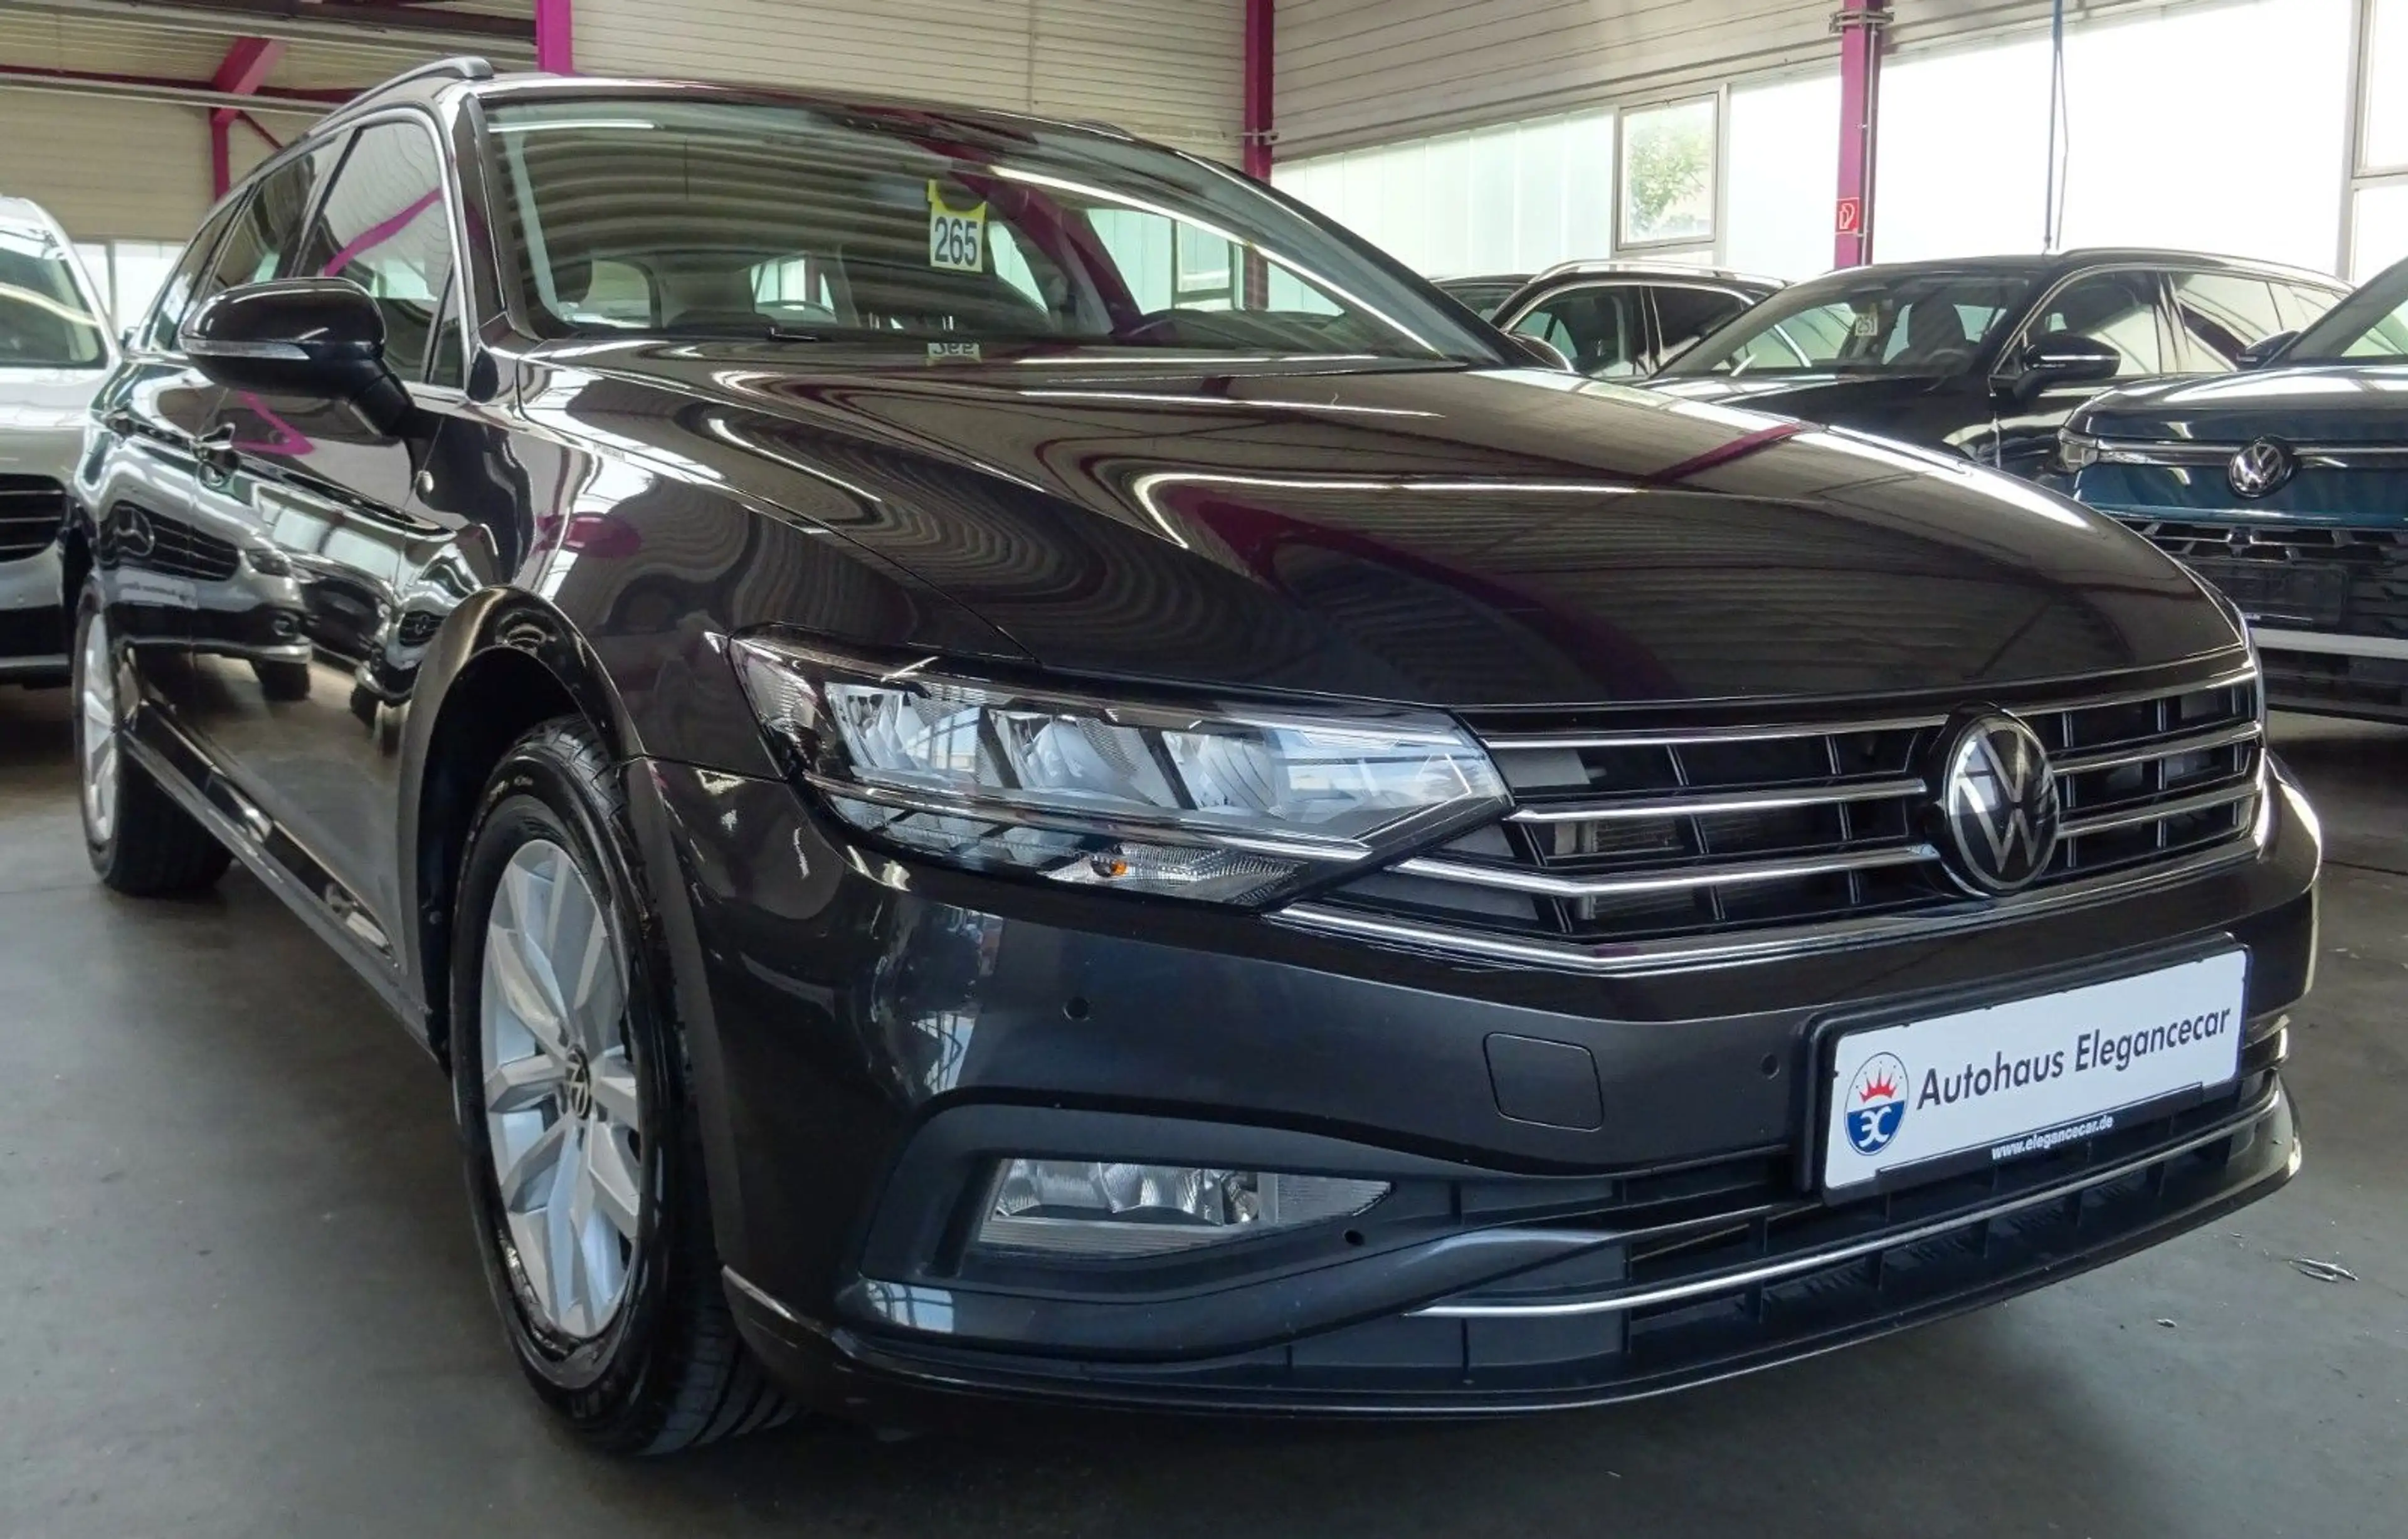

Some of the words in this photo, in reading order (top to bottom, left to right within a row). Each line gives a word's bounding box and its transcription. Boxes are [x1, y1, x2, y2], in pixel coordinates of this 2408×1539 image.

[934, 216, 977, 266] 265
[1950, 723, 2058, 879] VW
[1916, 1050, 2064, 1110] Autohaus
[2075, 1006, 2231, 1072] Elegancecar
[1991, 1114, 2114, 1160] www.elegancecar.de
